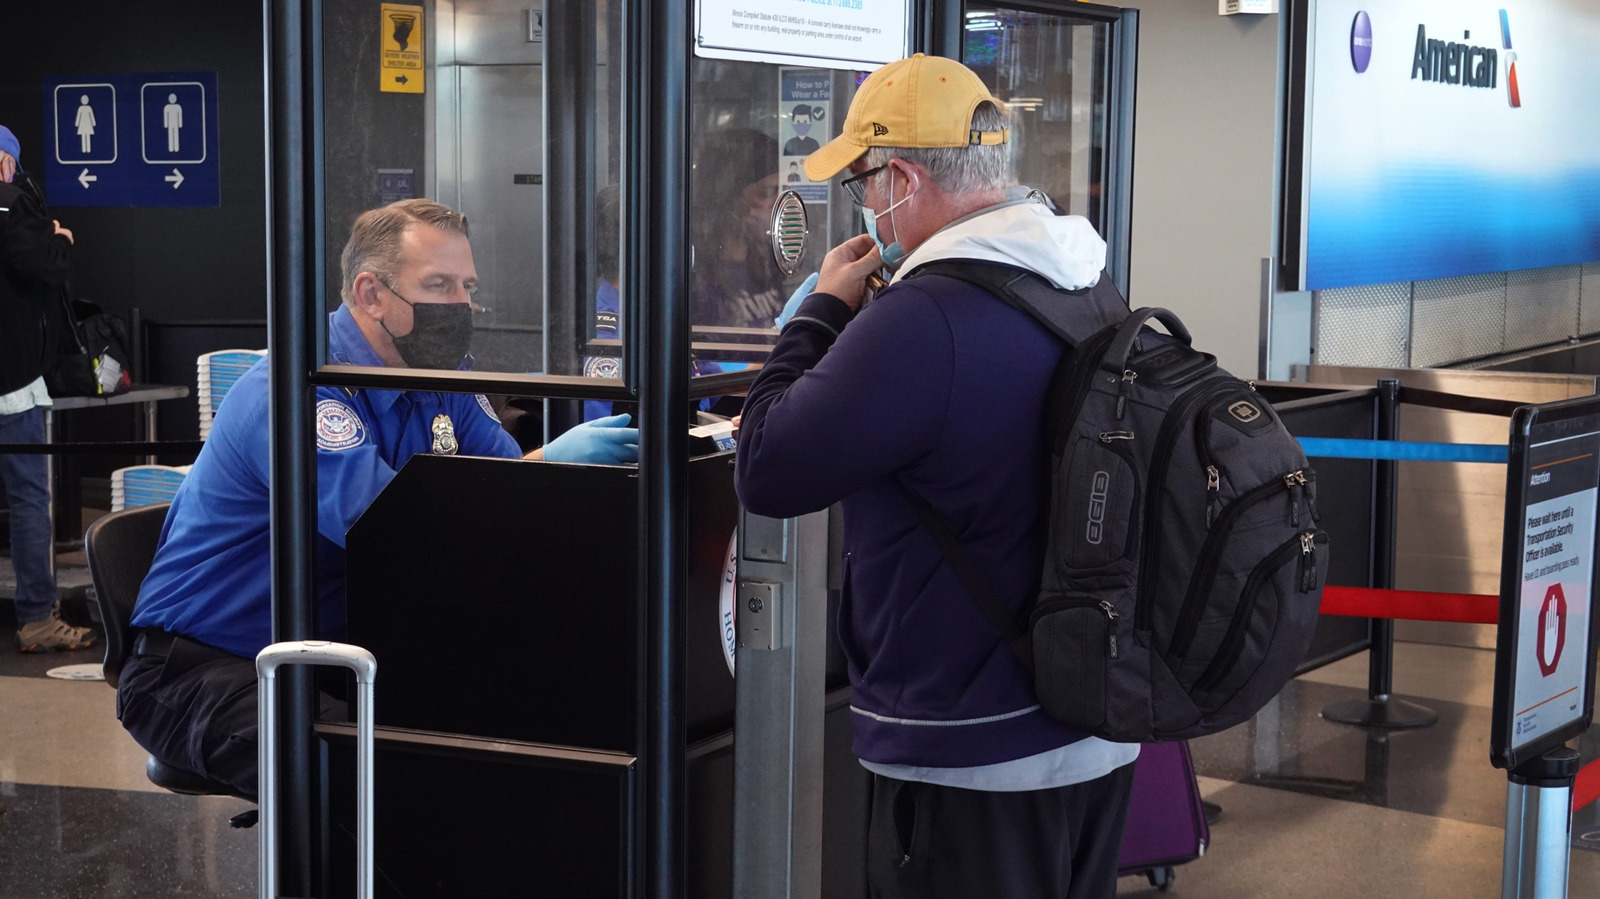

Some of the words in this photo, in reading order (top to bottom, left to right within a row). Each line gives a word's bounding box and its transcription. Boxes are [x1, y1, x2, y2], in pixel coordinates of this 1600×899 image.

[1411, 23, 1497, 89] American
[791, 90, 811, 99] Wear
[796, 81, 814, 89] How
[815, 81, 823, 89] to
[1530, 471, 1551, 486] Attention
[1086, 470, 1110, 545] OGIO
[1528, 516, 1541, 529] Please
[1542, 511, 1551, 526] wait
[1551, 511, 1561, 522] here
[1561, 506, 1571, 519] until
[1527, 526, 1557, 546] Transportation
[1557, 522, 1574, 537] Security
[1526, 549, 1540, 563] Officer
[1540, 546, 1545, 558] is
